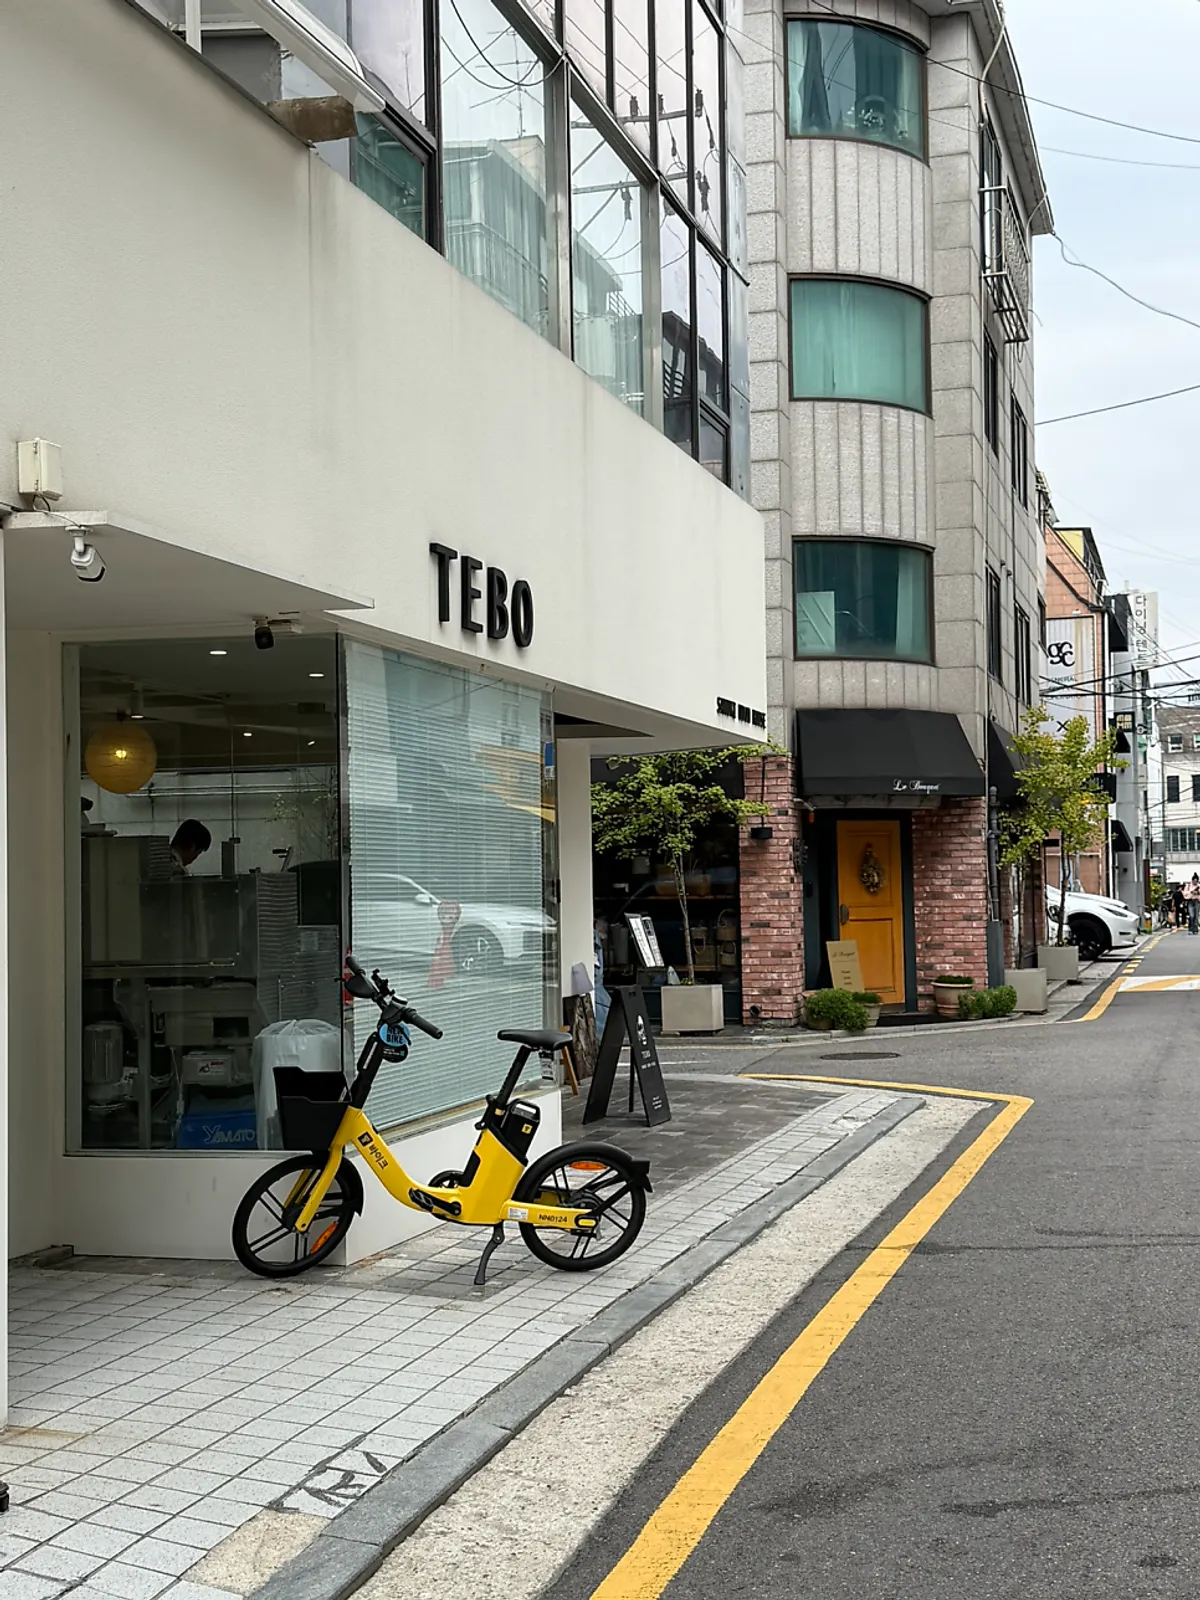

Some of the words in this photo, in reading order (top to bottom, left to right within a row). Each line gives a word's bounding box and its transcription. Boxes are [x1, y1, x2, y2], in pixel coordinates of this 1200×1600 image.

[429, 542, 534, 648] TEBO
[385, 1033, 405, 1045] BIKE
[368, 1143, 389, 1170] 바이크
